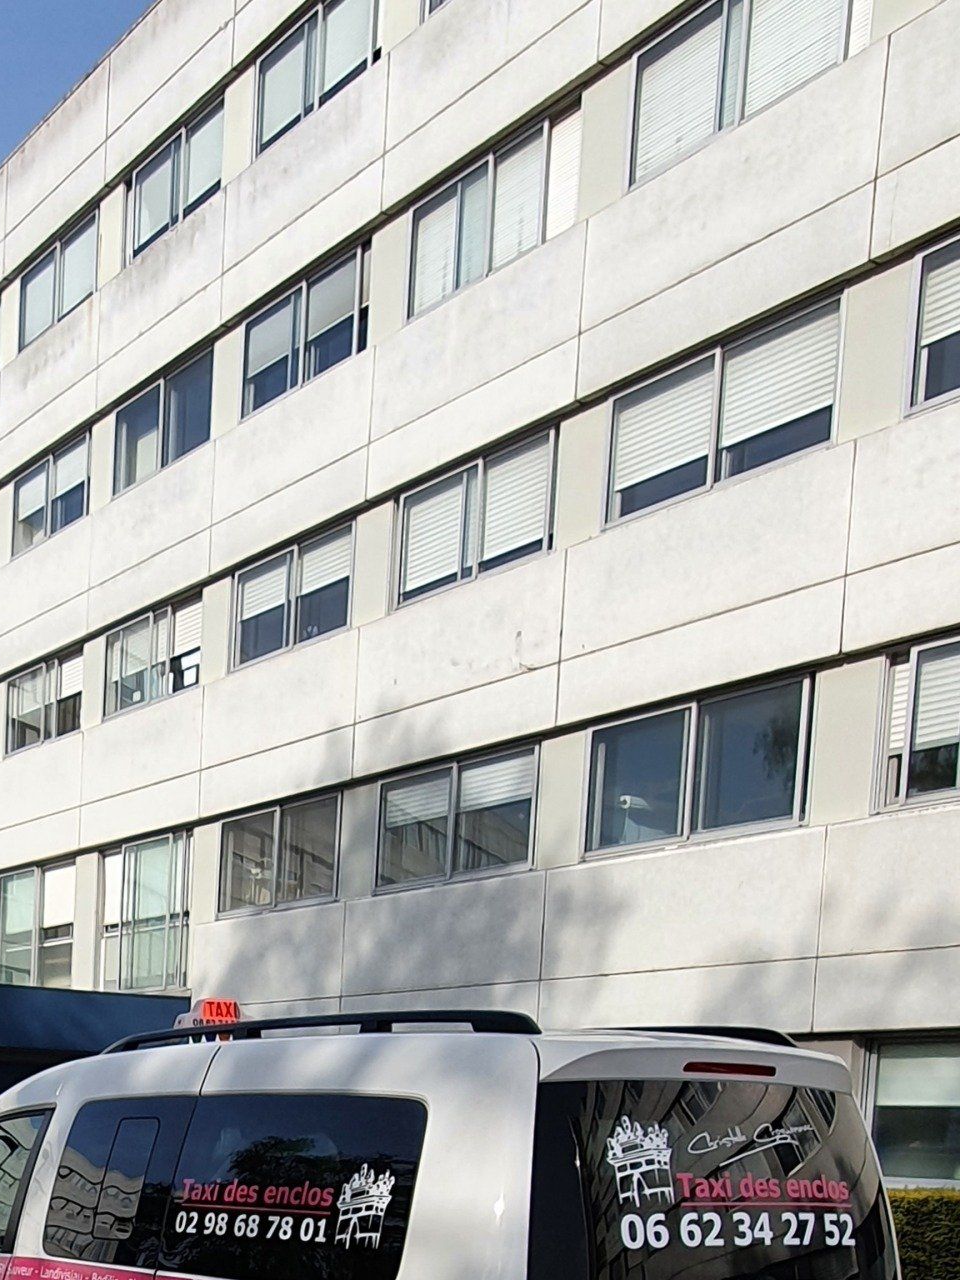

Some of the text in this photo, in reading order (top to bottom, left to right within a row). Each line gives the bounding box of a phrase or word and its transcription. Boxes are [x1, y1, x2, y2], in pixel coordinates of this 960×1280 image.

[206, 1001, 238, 1018] TAXI
[182, 1178, 334, 1207] Taxi des enclos
[675, 1172, 850, 1200] Taxi des enclos
[175, 1211, 327, 1242] 02 98 68 78 01
[620, 1212, 856, 1250] 06 62 34 27 52
